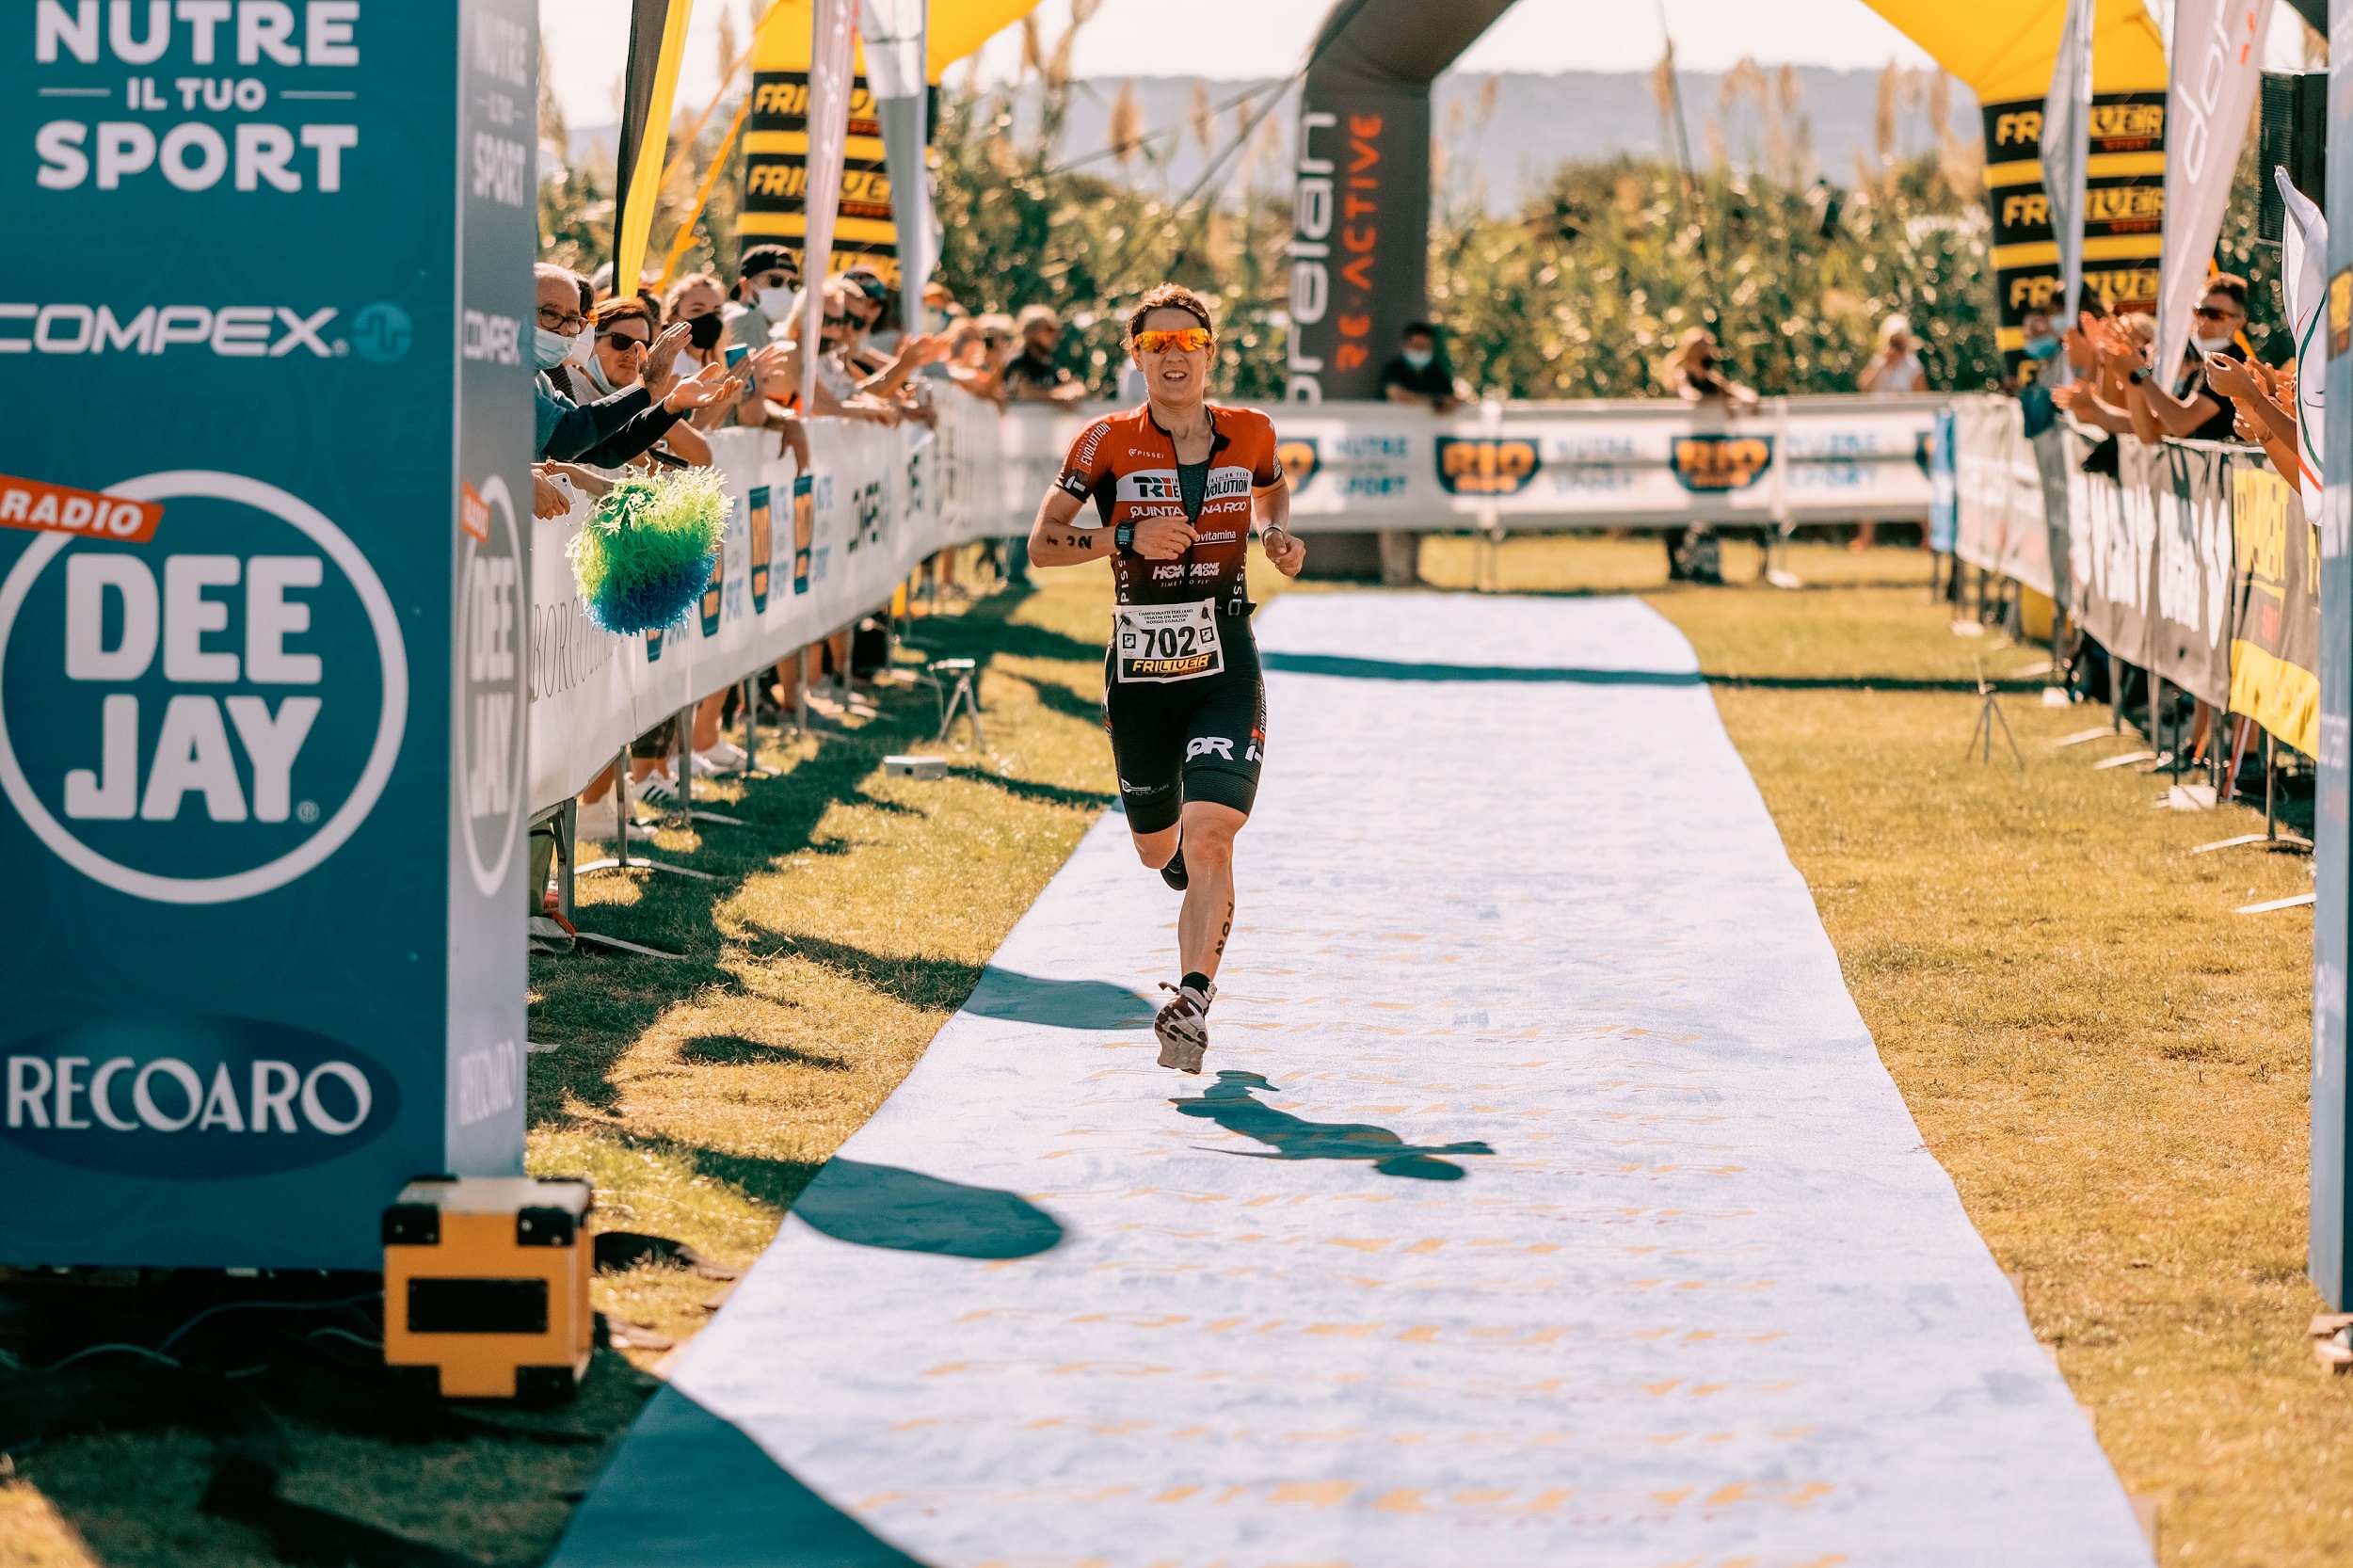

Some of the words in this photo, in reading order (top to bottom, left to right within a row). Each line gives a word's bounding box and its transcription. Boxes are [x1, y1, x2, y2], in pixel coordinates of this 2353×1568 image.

[36, 0, 360, 66] NUTRE
[126, 78, 168, 111] IL
[176, 78, 267, 111] TUO
[36, 120, 359, 192] SPORT
[1080, 421, 1112, 467] EVOLUTION
[1137, 450, 1164, 459] PISSEI
[0, 489, 144, 536] RADIO
[1203, 568, 1220, 577] ONE
[65, 553, 324, 684] DEE
[1140, 626, 1198, 658] 702
[1132, 654, 1209, 672] FRILIVER
[64, 694, 323, 823] JAY
[1214, 901, 1234, 957] 702
[7, 1056, 373, 1135] RECOARO
